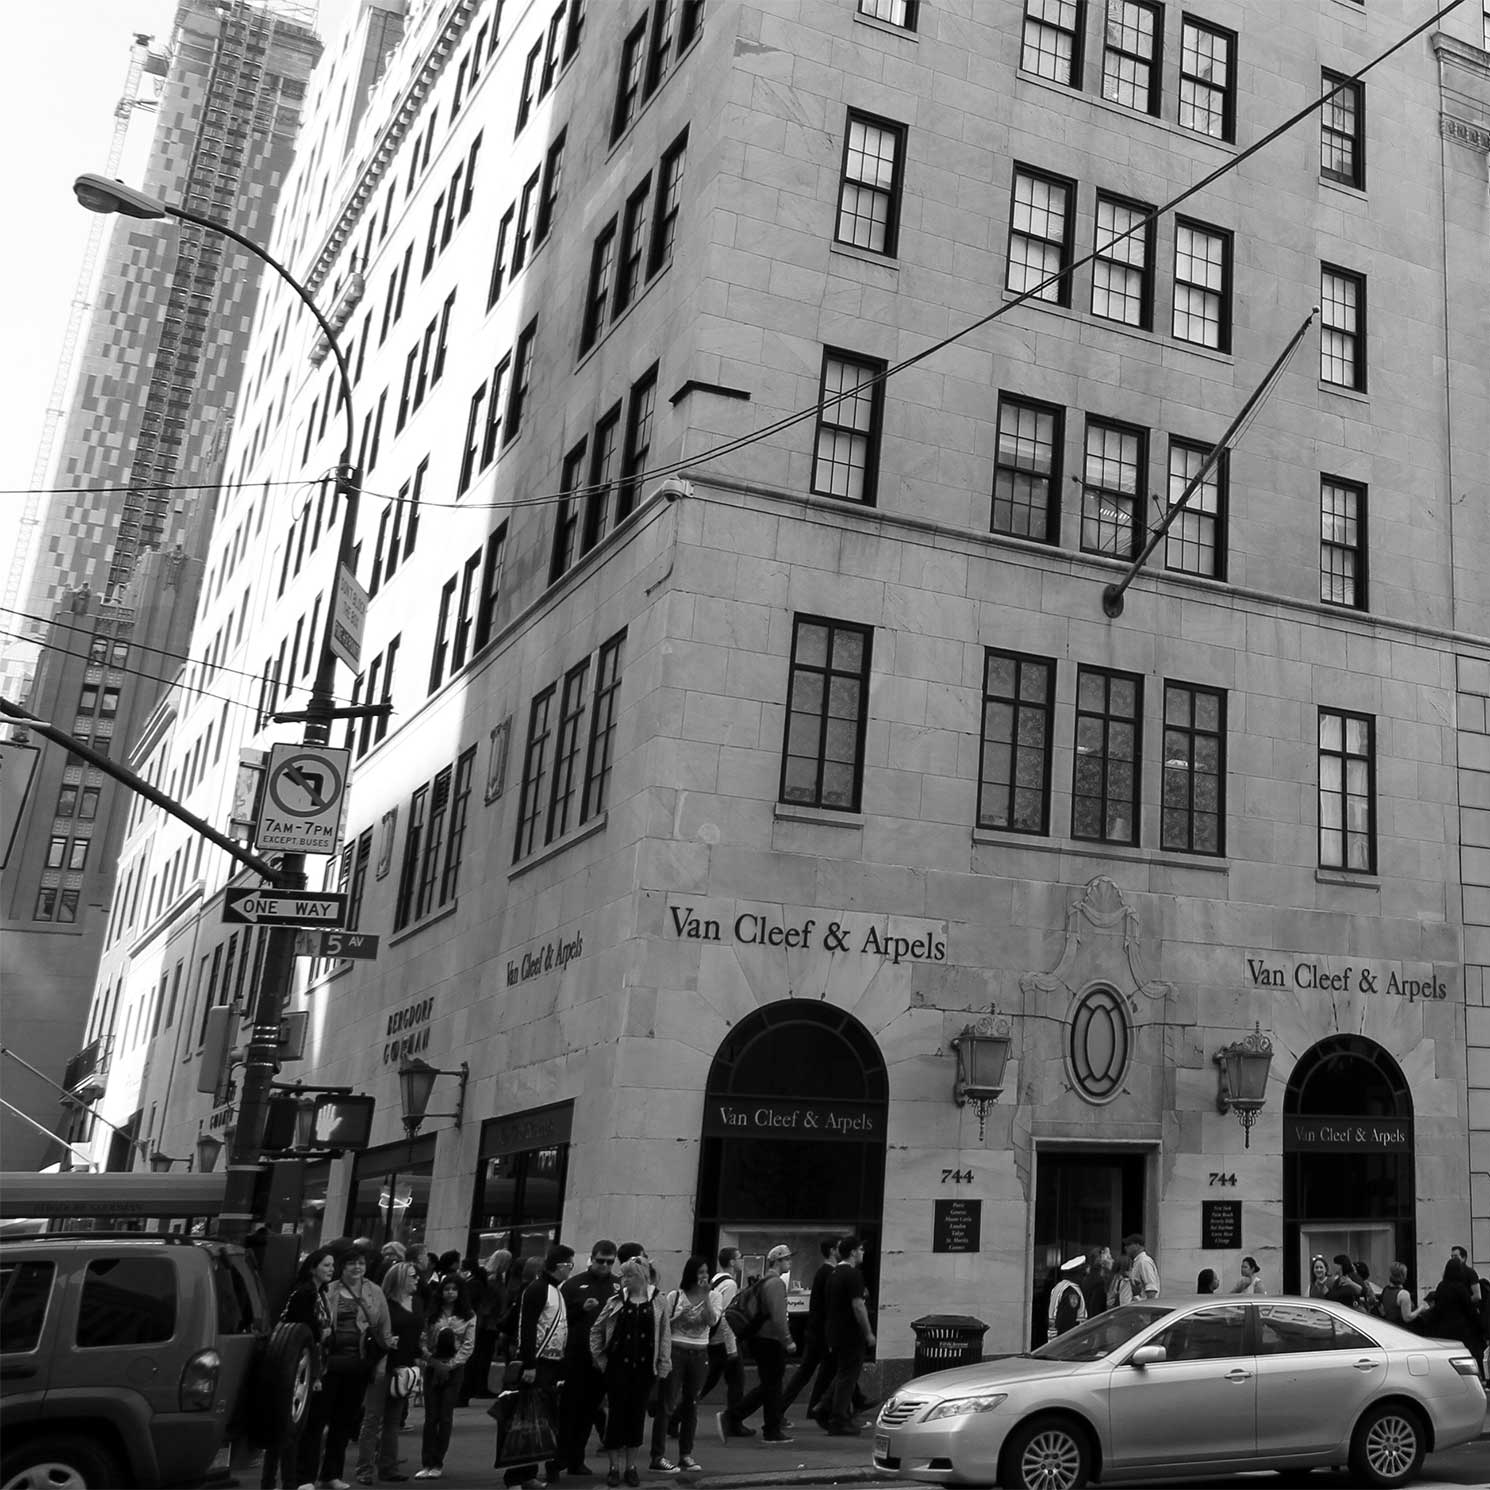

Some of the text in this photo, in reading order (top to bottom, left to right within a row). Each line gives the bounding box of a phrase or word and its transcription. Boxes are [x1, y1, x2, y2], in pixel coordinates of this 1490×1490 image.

[263, 835, 329, 848] EXCEPT BUSES
[243, 899, 332, 917] ONE WAY
[326, 935, 365, 955] 5 AV
[670, 906, 946, 964] Van Cleef & Arpels
[506, 930, 583, 988] Van Cleef & Arpels
[1247, 959, 1447, 1002] Van Cleef & Arpels
[386, 996, 434, 1036] BERGDORF
[720, 1107, 873, 1134] Van Cleef & Arpels
[1295, 1126, 1405, 1146] Van Cleef & Arpels
[941, 1169, 975, 1184] 744
[1209, 1173, 1238, 1186] 744
